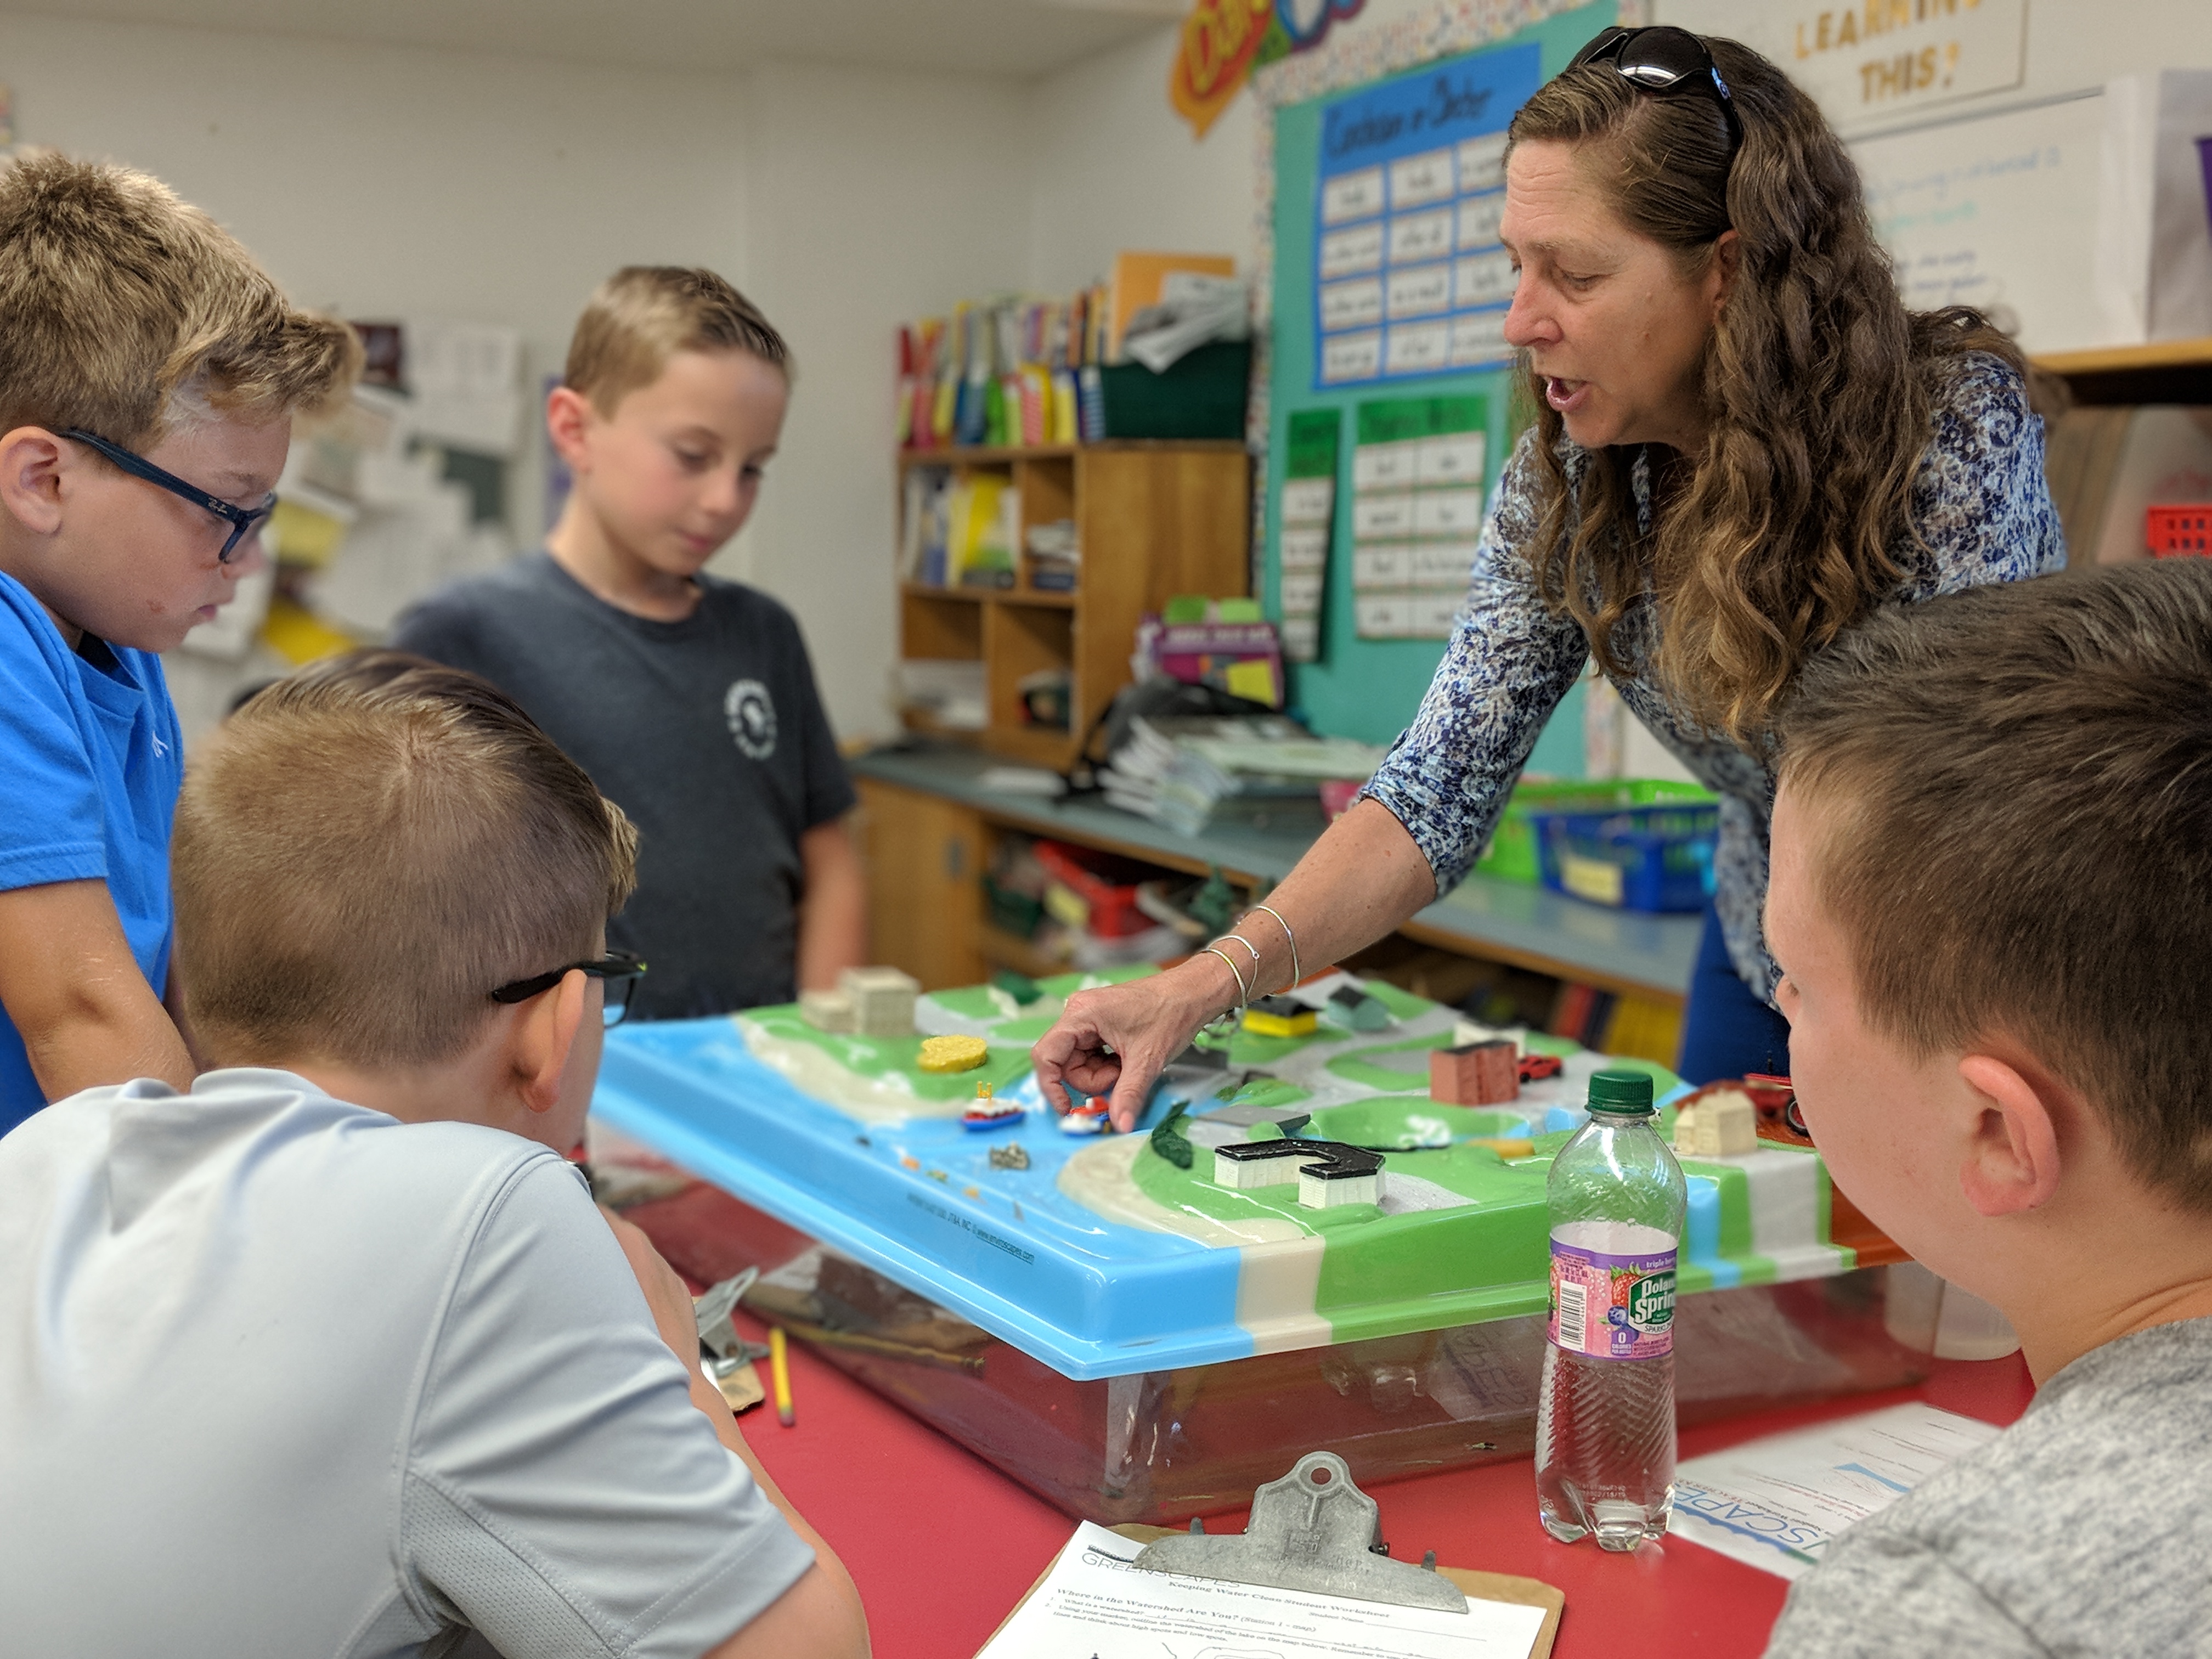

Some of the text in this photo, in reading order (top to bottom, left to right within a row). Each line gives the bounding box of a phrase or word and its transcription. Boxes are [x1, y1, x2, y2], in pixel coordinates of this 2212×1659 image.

[1795, 0, 1982, 60] LEARNI
[1641, 1277, 1676, 1298] Polan
[1635, 1291, 1676, 1324] Sprin
[1618, 1331, 1627, 1344] 0
[1673, 1482, 1830, 1550] SCAPE
[1058, 1589, 1091, 1599] Where
[1126, 1599, 1184, 1612] Watershed
[1211, 1611, 1239, 1620] You?
[1059, 1605, 1080, 1613] Using
[1099, 1605, 1144, 1616] watershed?
[1169, 1582, 1391, 1618] Keeping Water Clean Student Worksheet
